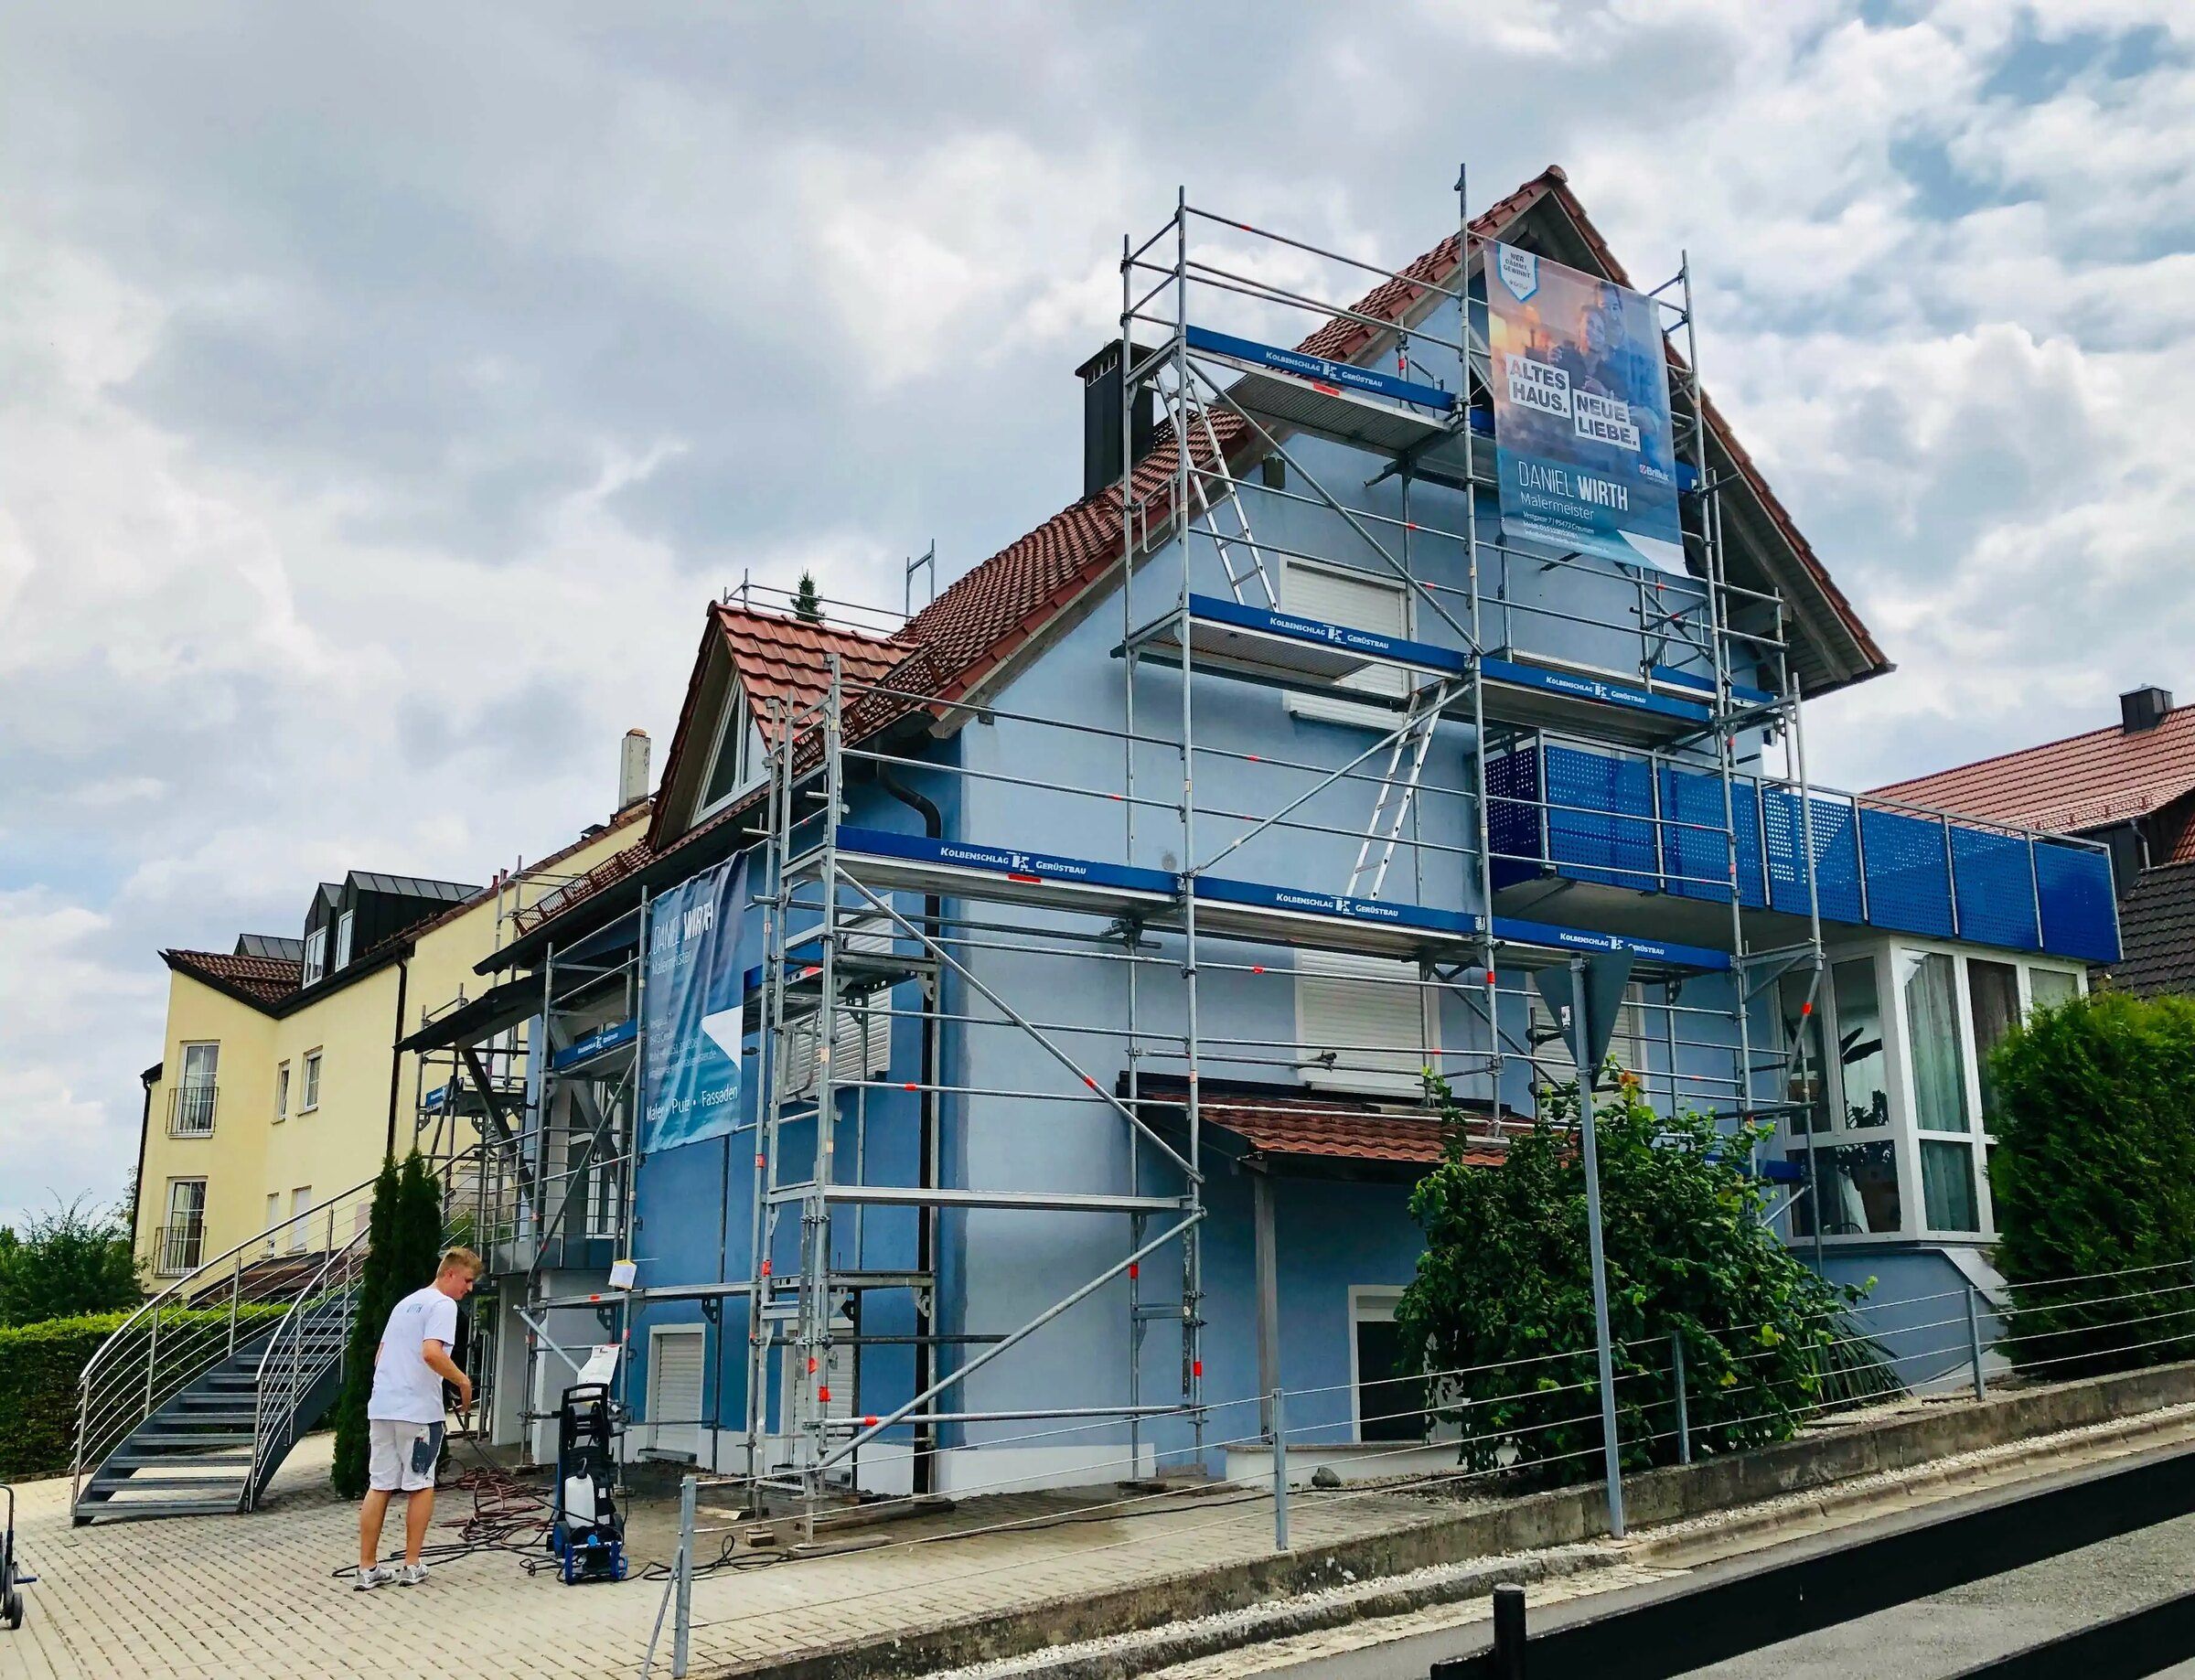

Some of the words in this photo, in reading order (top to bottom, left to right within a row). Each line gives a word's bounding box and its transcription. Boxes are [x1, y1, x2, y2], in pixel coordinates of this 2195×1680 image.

[1266, 351, 1321, 372] KOLBENSCHLAG
[1342, 371, 1383, 388] GERÜSTBAU
[1510, 359, 1567, 391] ALTES
[1513, 381, 1568, 413] HAUS.
[1576, 394, 1627, 423] NEUE
[1578, 416, 1637, 446] LIEBE.
[1518, 460, 1575, 498] DANIEL
[1578, 475, 1629, 512] WIRTH
[1520, 491, 1595, 520] Malermeister
[1269, 616, 1326, 637] KOLBENSCHLAG
[1347, 634, 1389, 649] GERÜSTBAU
[1546, 676, 1593, 693] KOLBENSCHLAG
[1611, 690, 1646, 704] GERÜSTBAU
[940, 847, 1009, 865] KOLBENSCHLAG
[1035, 861, 1087, 875] GERÜSTBAU
[683, 898, 714, 942] WIRTH
[1276, 893, 1333, 908] KOLBENSCHLAG
[1355, 904, 1399, 917] GERÜSTBAU
[1559, 932, 1609, 947] KOLBENSCHLAG
[646, 1103, 665, 1123] Maler
[701, 1084, 738, 1108] Fassaden
